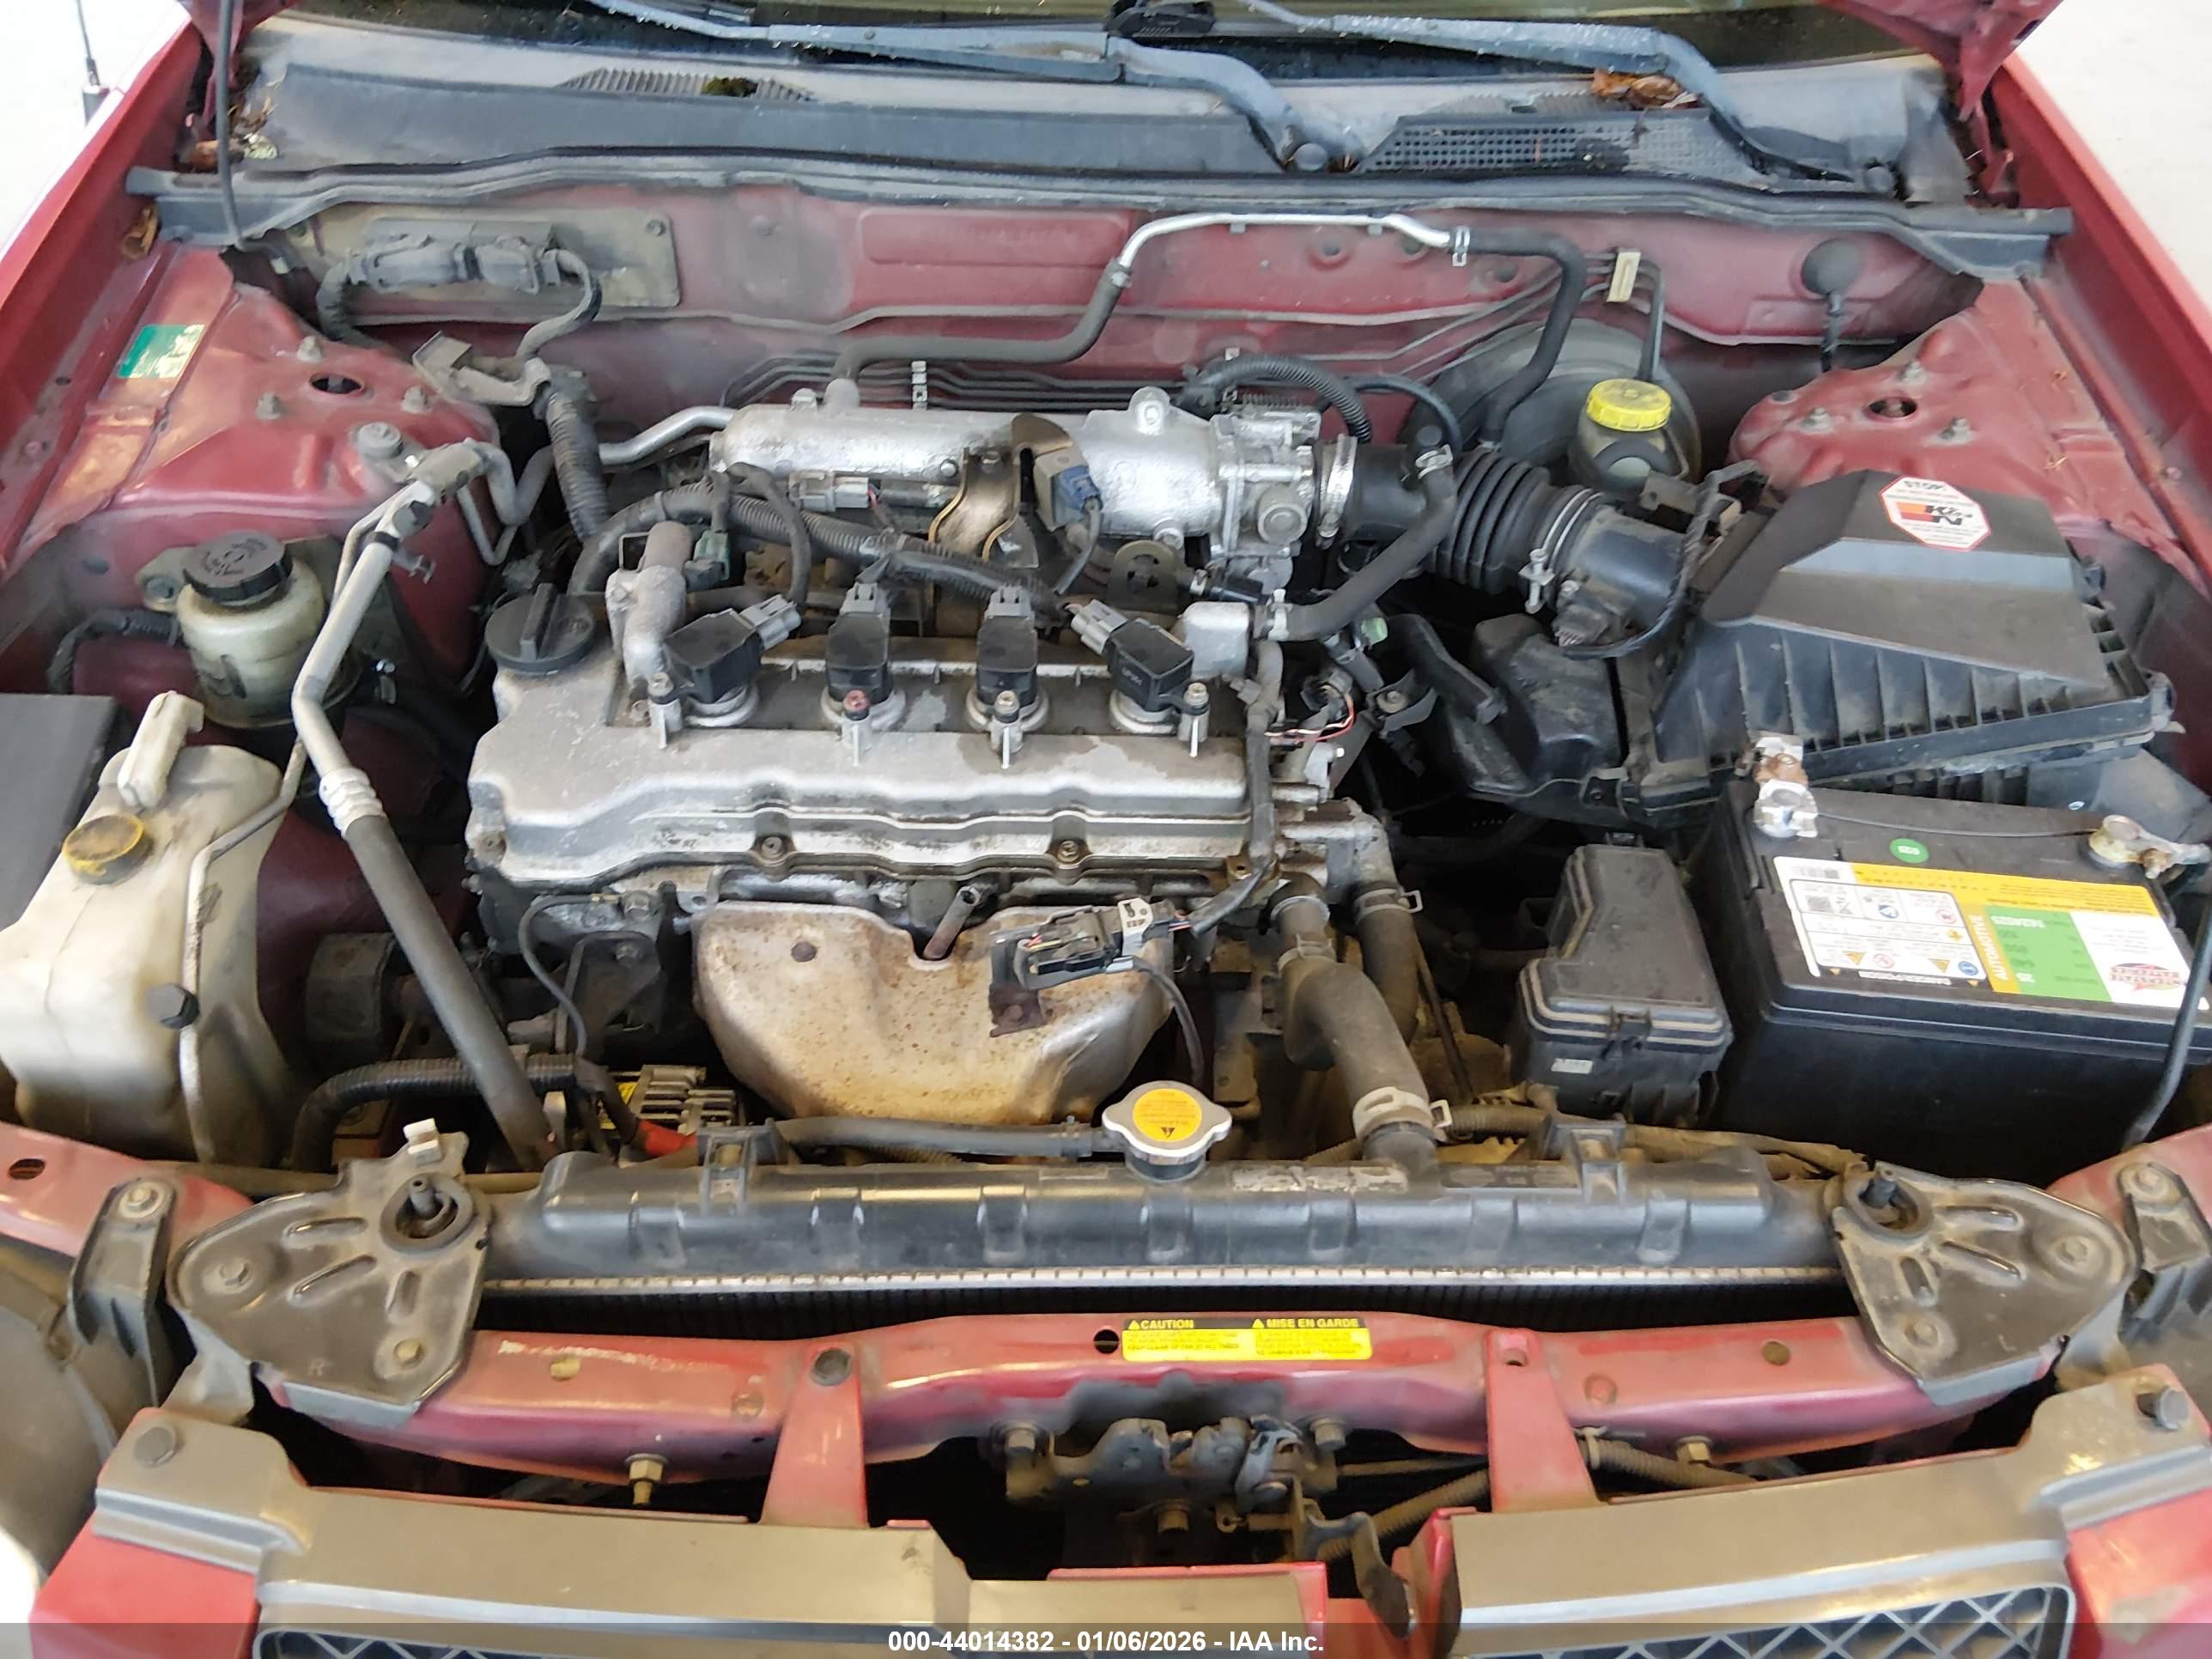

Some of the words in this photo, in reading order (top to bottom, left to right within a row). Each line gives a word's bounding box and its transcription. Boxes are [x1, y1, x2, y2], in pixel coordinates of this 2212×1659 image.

[1967, 915, 2010, 980] AUTOMOTIVE
[1140, 1319, 1194, 1329] CAUTION
[1267, 1318, 1296, 1328] MISE
[1297, 1318, 1315, 1328] EN
[1316, 1318, 1359, 1328] GARDE
